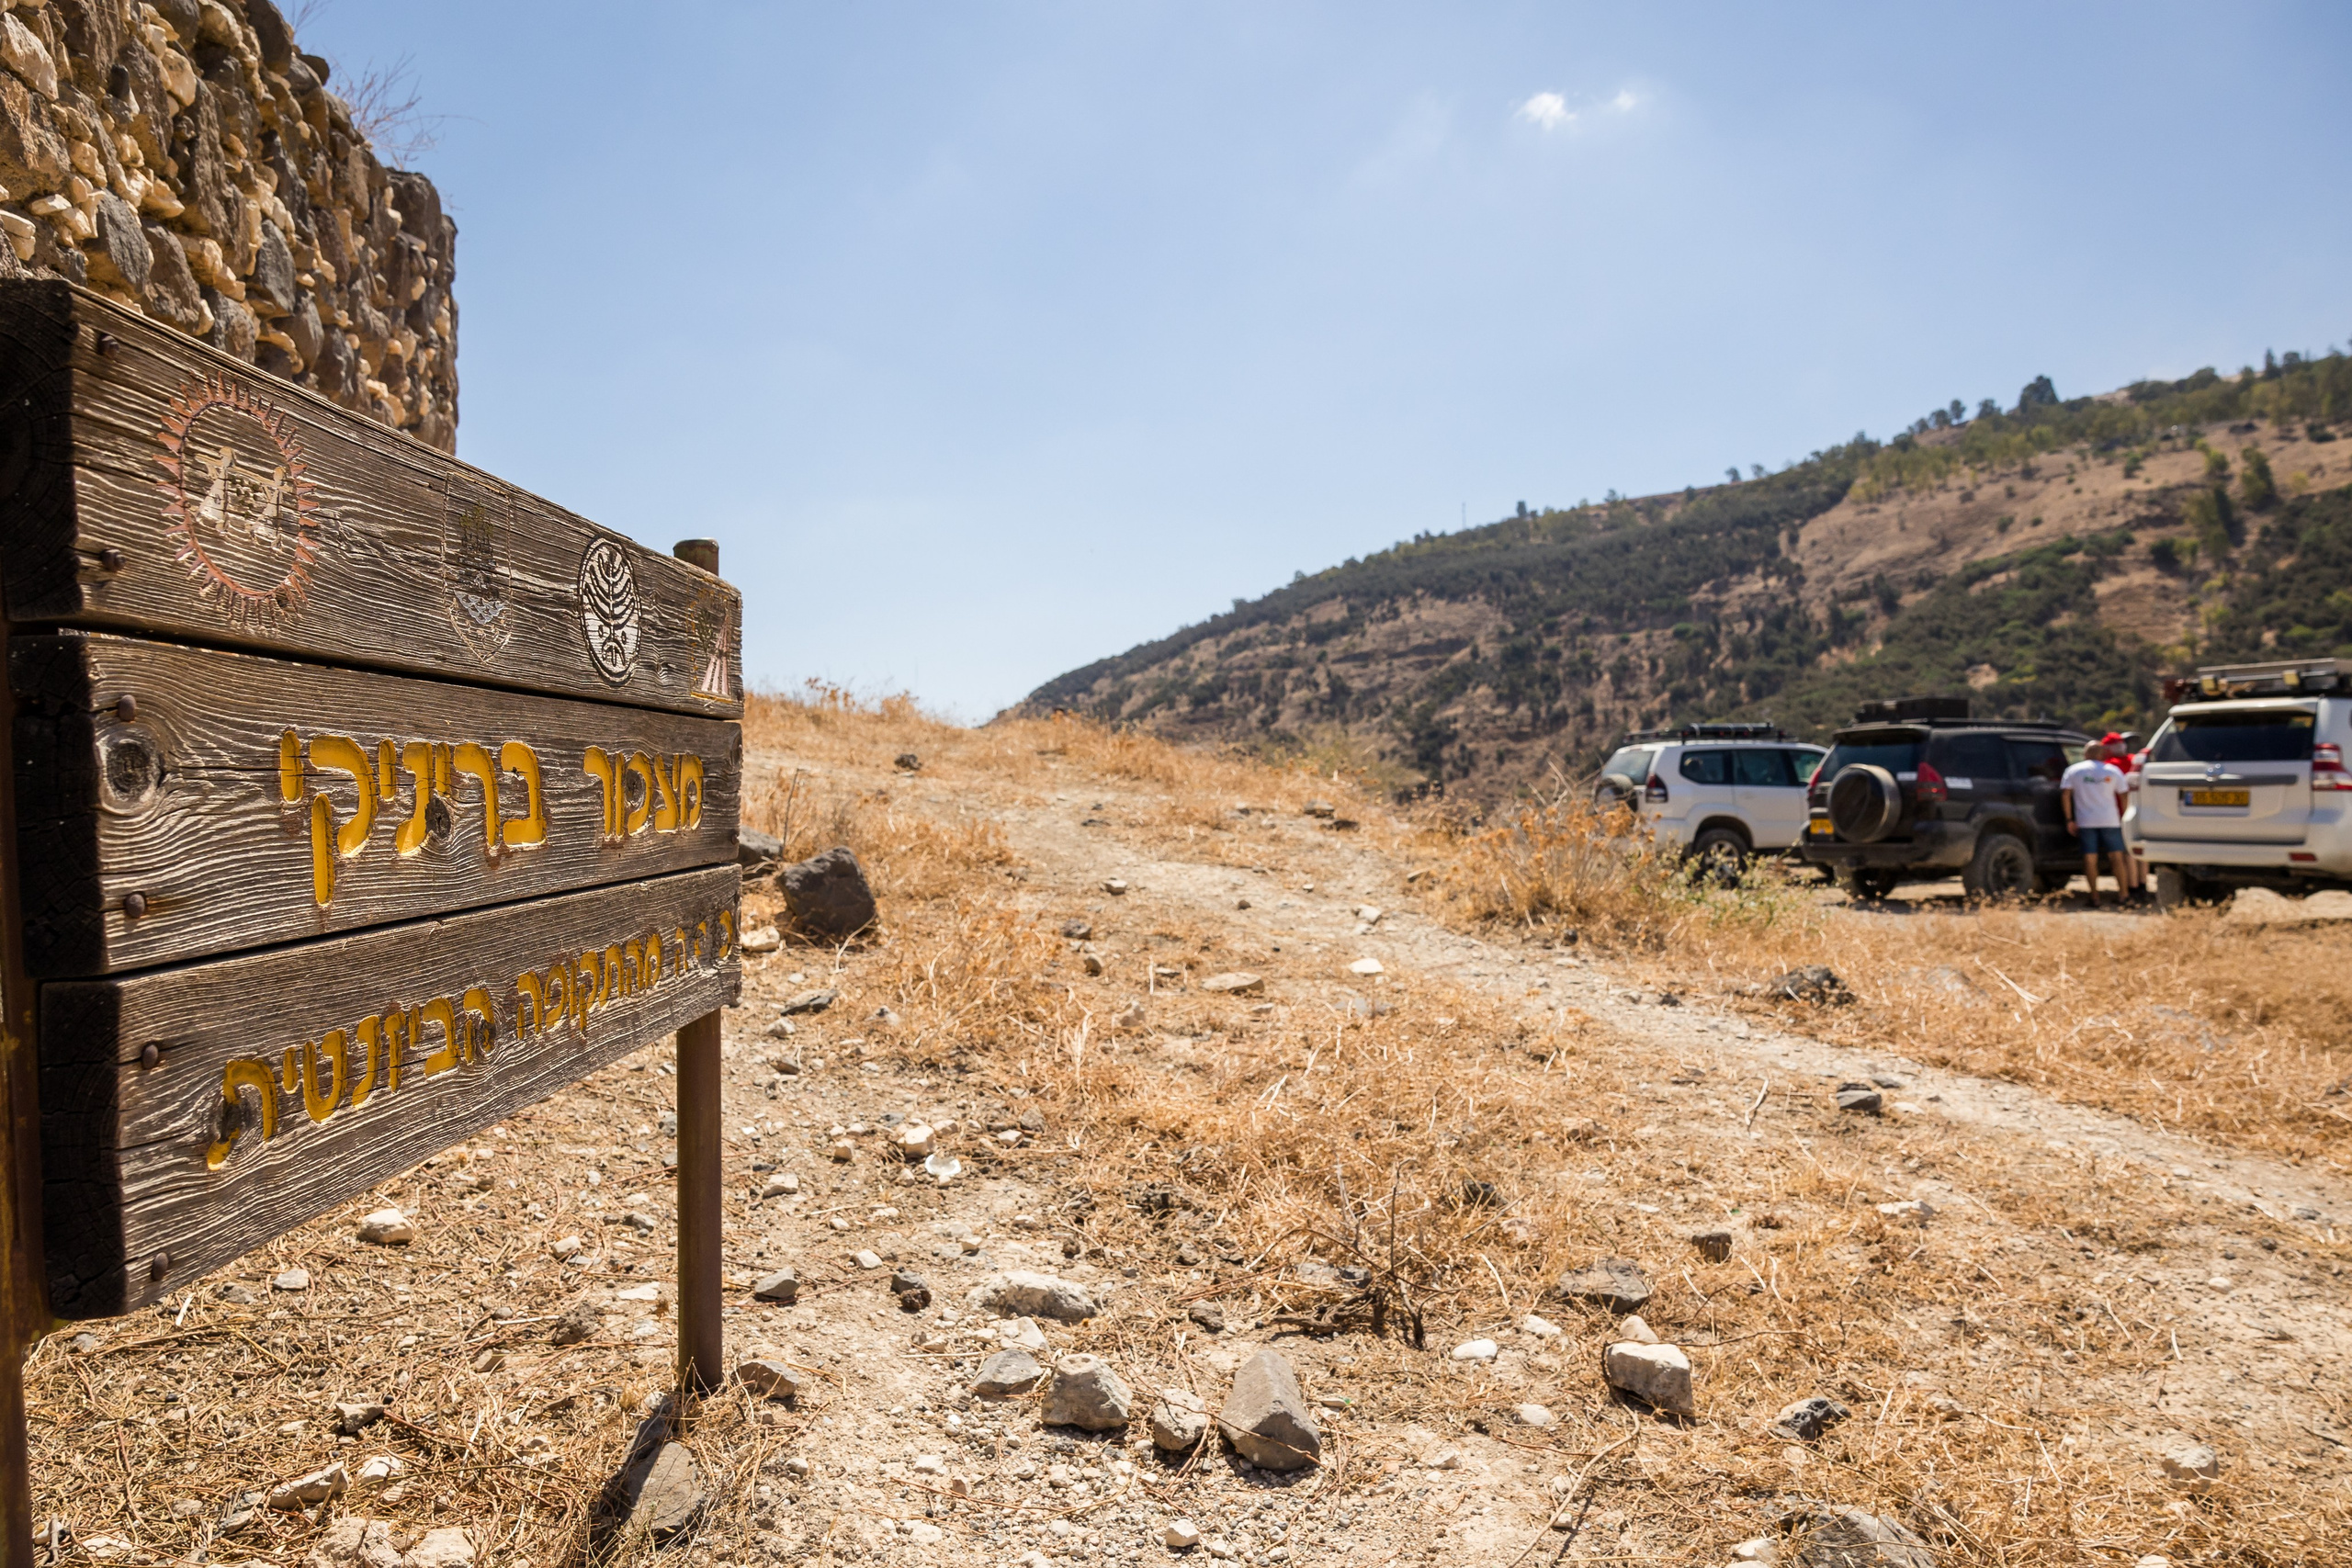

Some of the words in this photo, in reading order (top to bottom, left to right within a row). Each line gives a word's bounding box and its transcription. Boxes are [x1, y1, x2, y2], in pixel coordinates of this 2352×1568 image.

[278, 730, 548, 906] בריניקי
[516, 933, 665, 1040] מהתקופה
[206, 988, 496, 1170] הביזנטית
